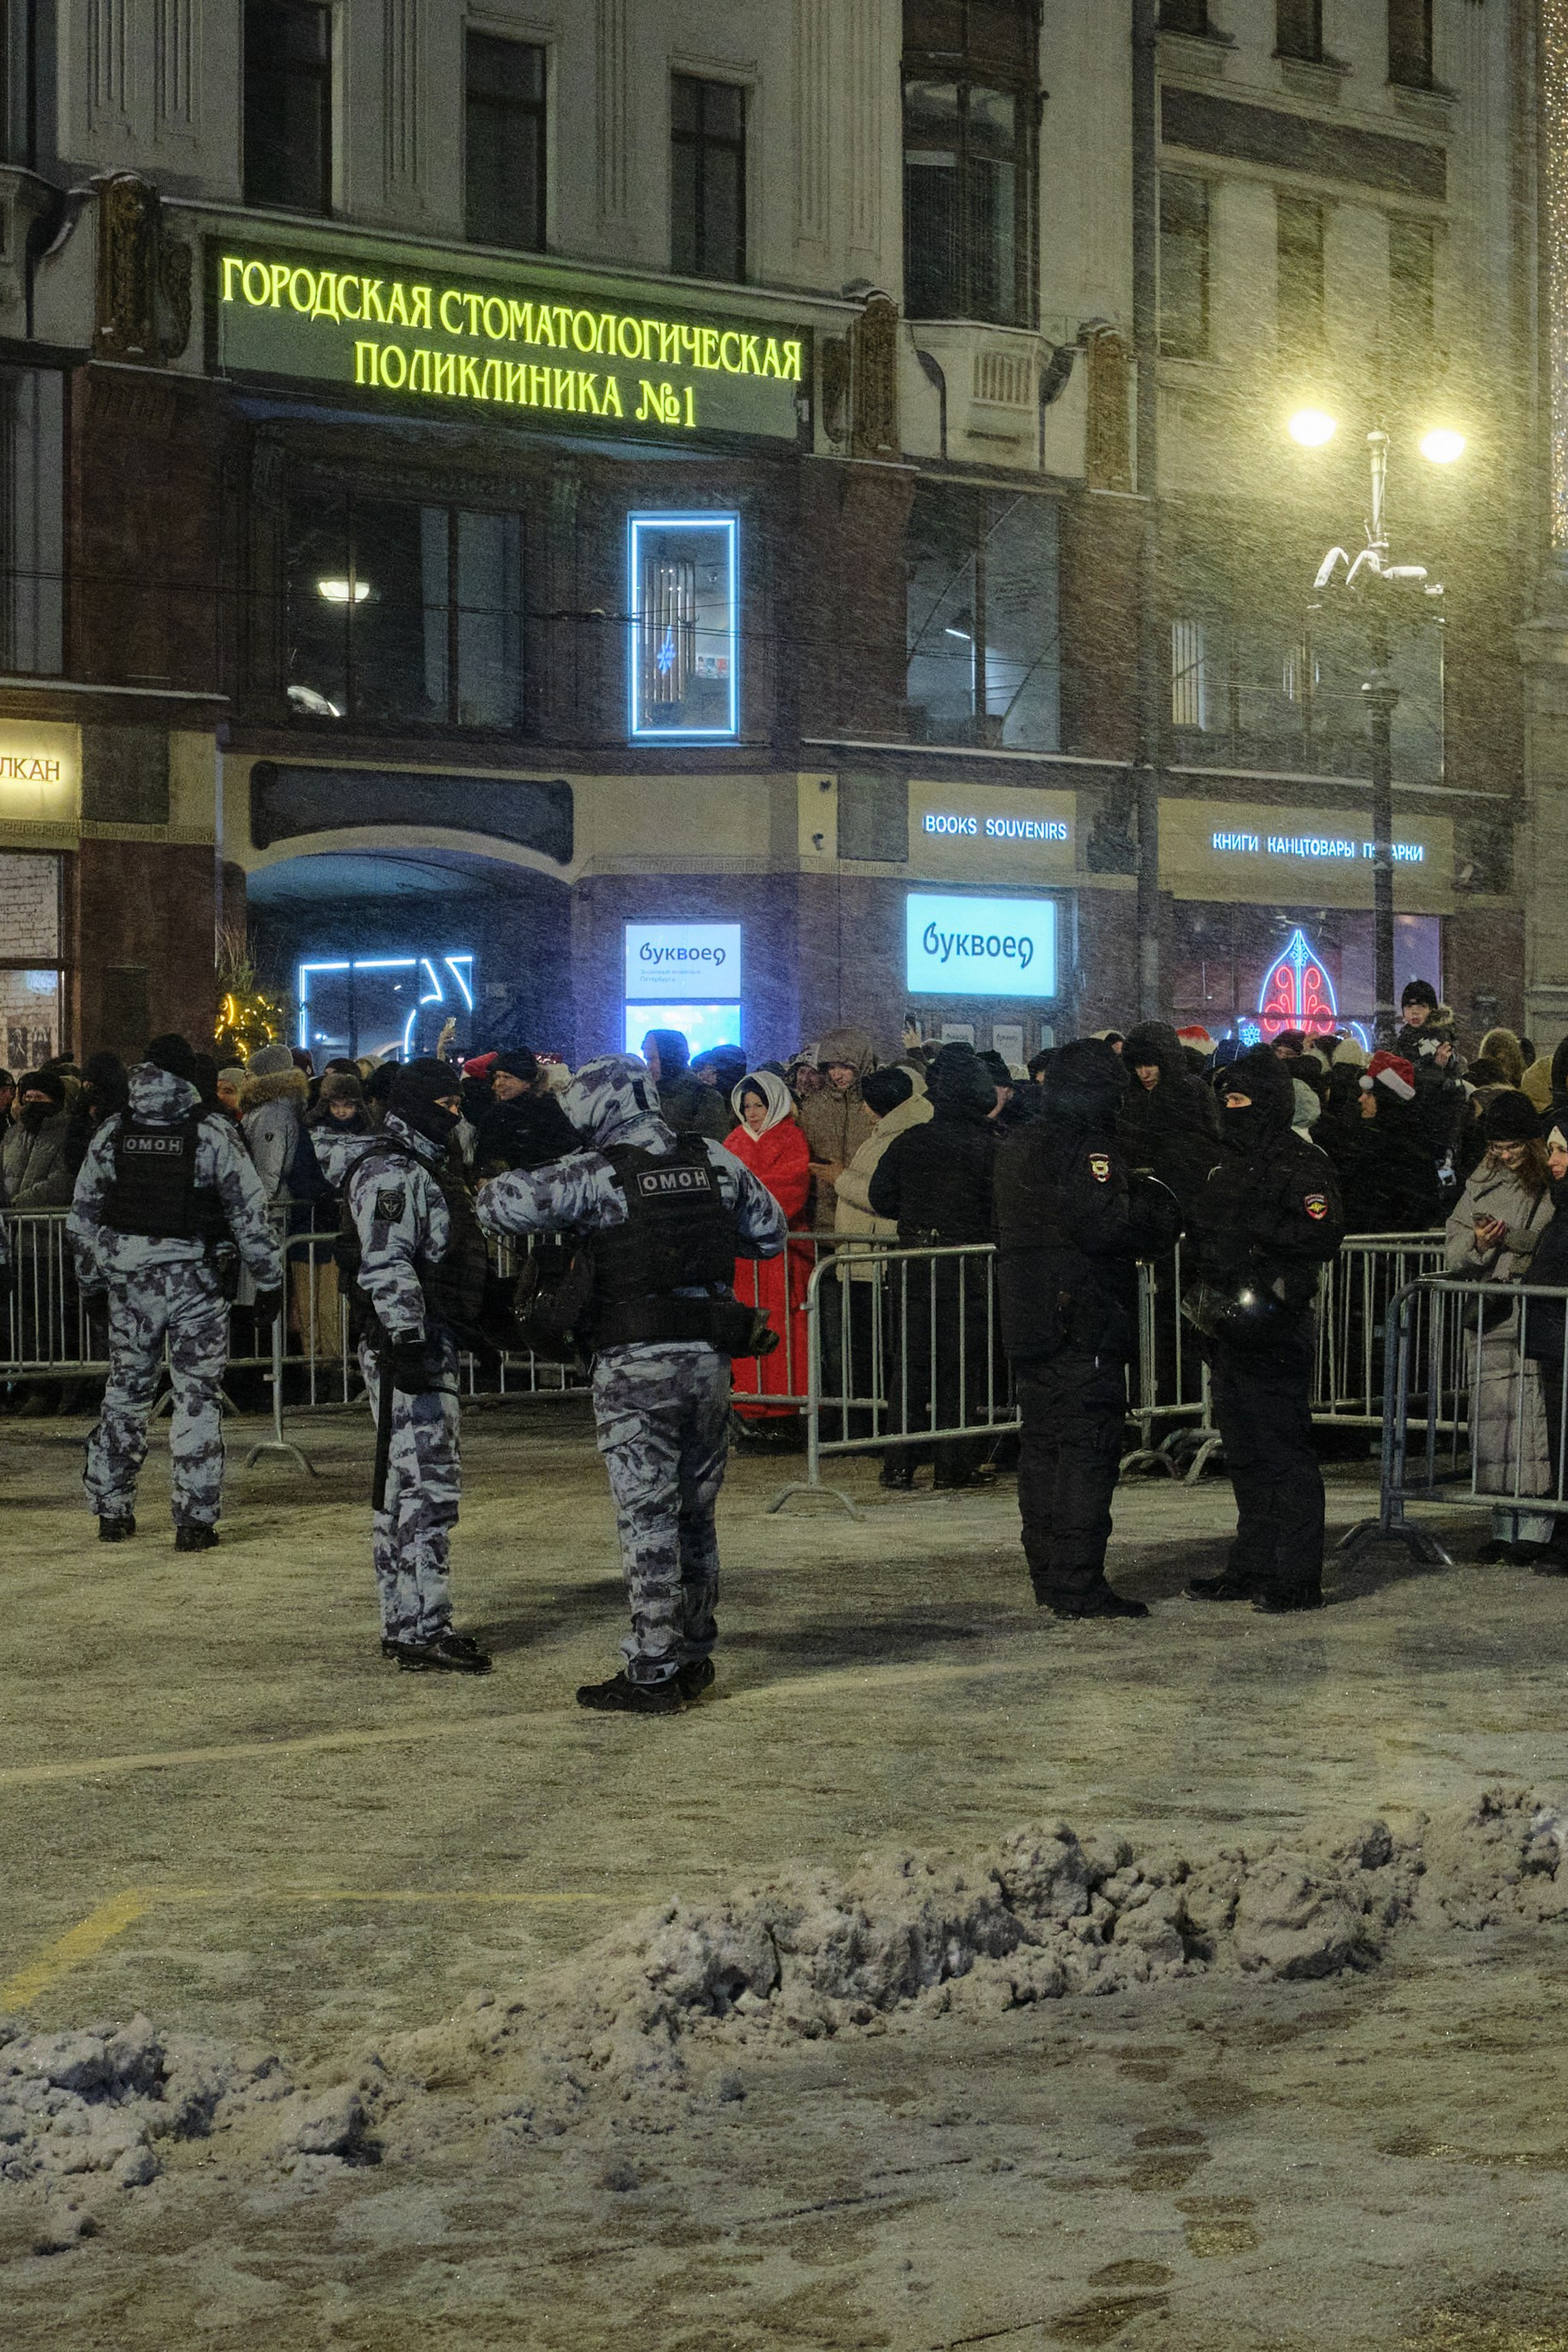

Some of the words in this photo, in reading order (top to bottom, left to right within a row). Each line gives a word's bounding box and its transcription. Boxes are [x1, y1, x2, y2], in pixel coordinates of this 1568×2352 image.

[222, 257, 432, 329] ГОРОДСКАЯ
[440, 291, 802, 381] СТОМАТОЛОГИЧЕСКАЯ
[355, 342, 624, 418] ПОЛИКЛИНИКА
[636, 380, 696, 427] №1
[0, 757, 59, 781] ЛКАН
[925, 815, 978, 835] BOOKS
[986, 818, 1067, 840] SOUVENIRS
[1213, 833, 1259, 851] КНИГИ
[1267, 836, 1355, 858] КАНЦТОВАРЫ
[1363, 842, 1423, 861] ПАРКИ
[126, 1138, 180, 1152] ОМОН
[643, 1171, 707, 1190] ОМОН
